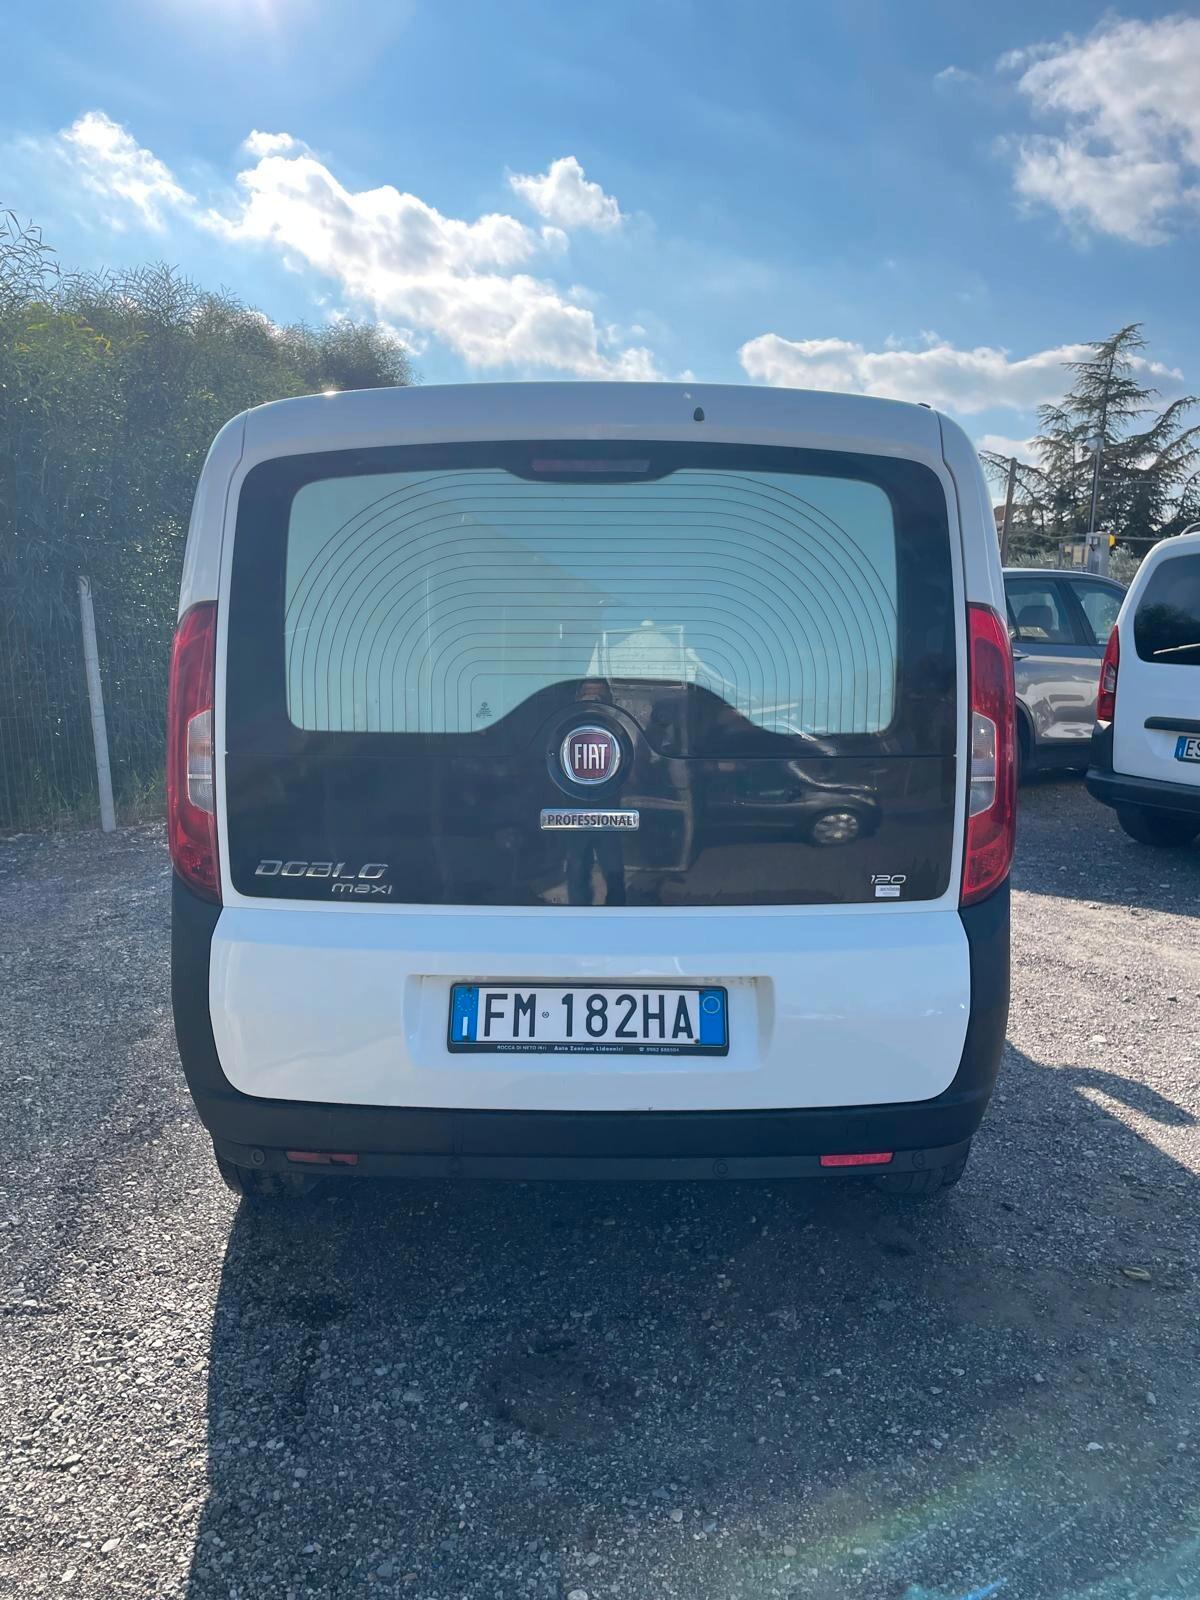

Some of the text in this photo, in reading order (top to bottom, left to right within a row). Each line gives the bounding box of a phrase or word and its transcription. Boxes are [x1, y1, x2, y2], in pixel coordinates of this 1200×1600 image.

[574, 743, 608, 770] FIAT
[547, 814, 633, 826] PROFESSIONAL
[870, 874, 906, 885] 120
[483, 992, 695, 1039] FM 182HA
